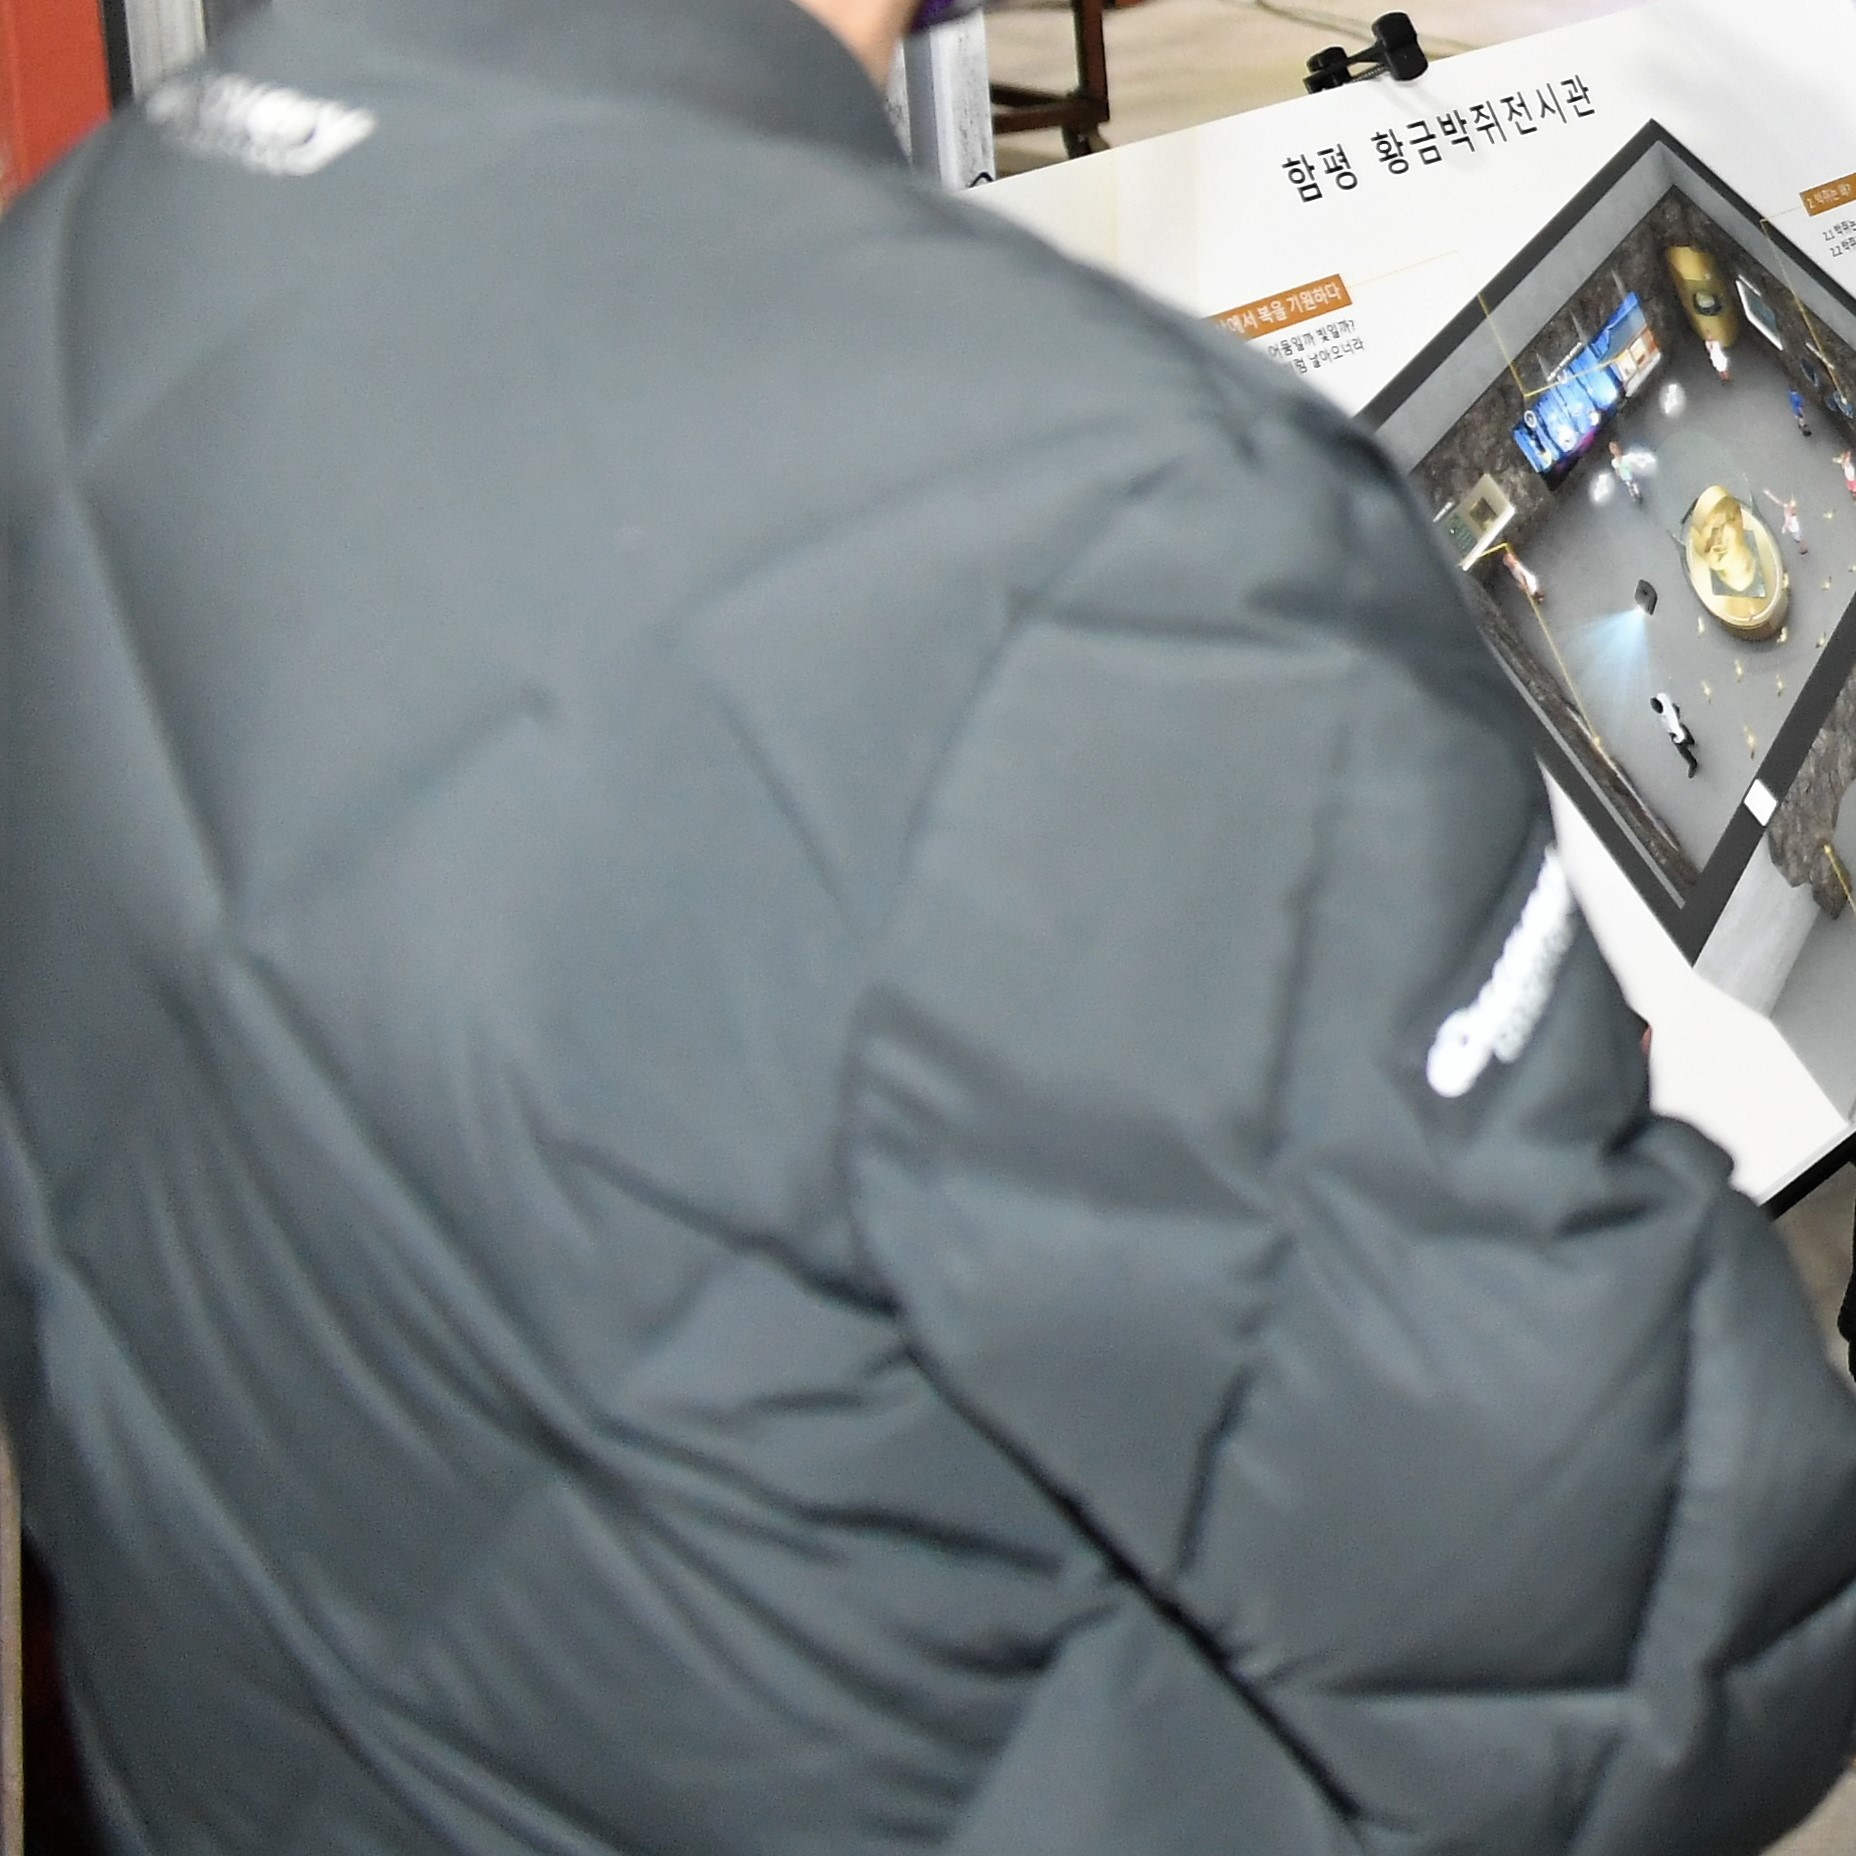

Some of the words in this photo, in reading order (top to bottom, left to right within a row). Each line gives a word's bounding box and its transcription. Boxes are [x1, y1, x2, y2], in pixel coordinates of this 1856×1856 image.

[1281, 143, 1358, 203] 함평
[1370, 74, 1596, 175] 황금박쥐전시관
[1258, 300, 1288, 324] 복을
[1286, 282, 1342, 313] 기원하다
[1267, 332, 1316, 359] 어둠일까
[1316, 319, 1356, 342] 빛일까?
